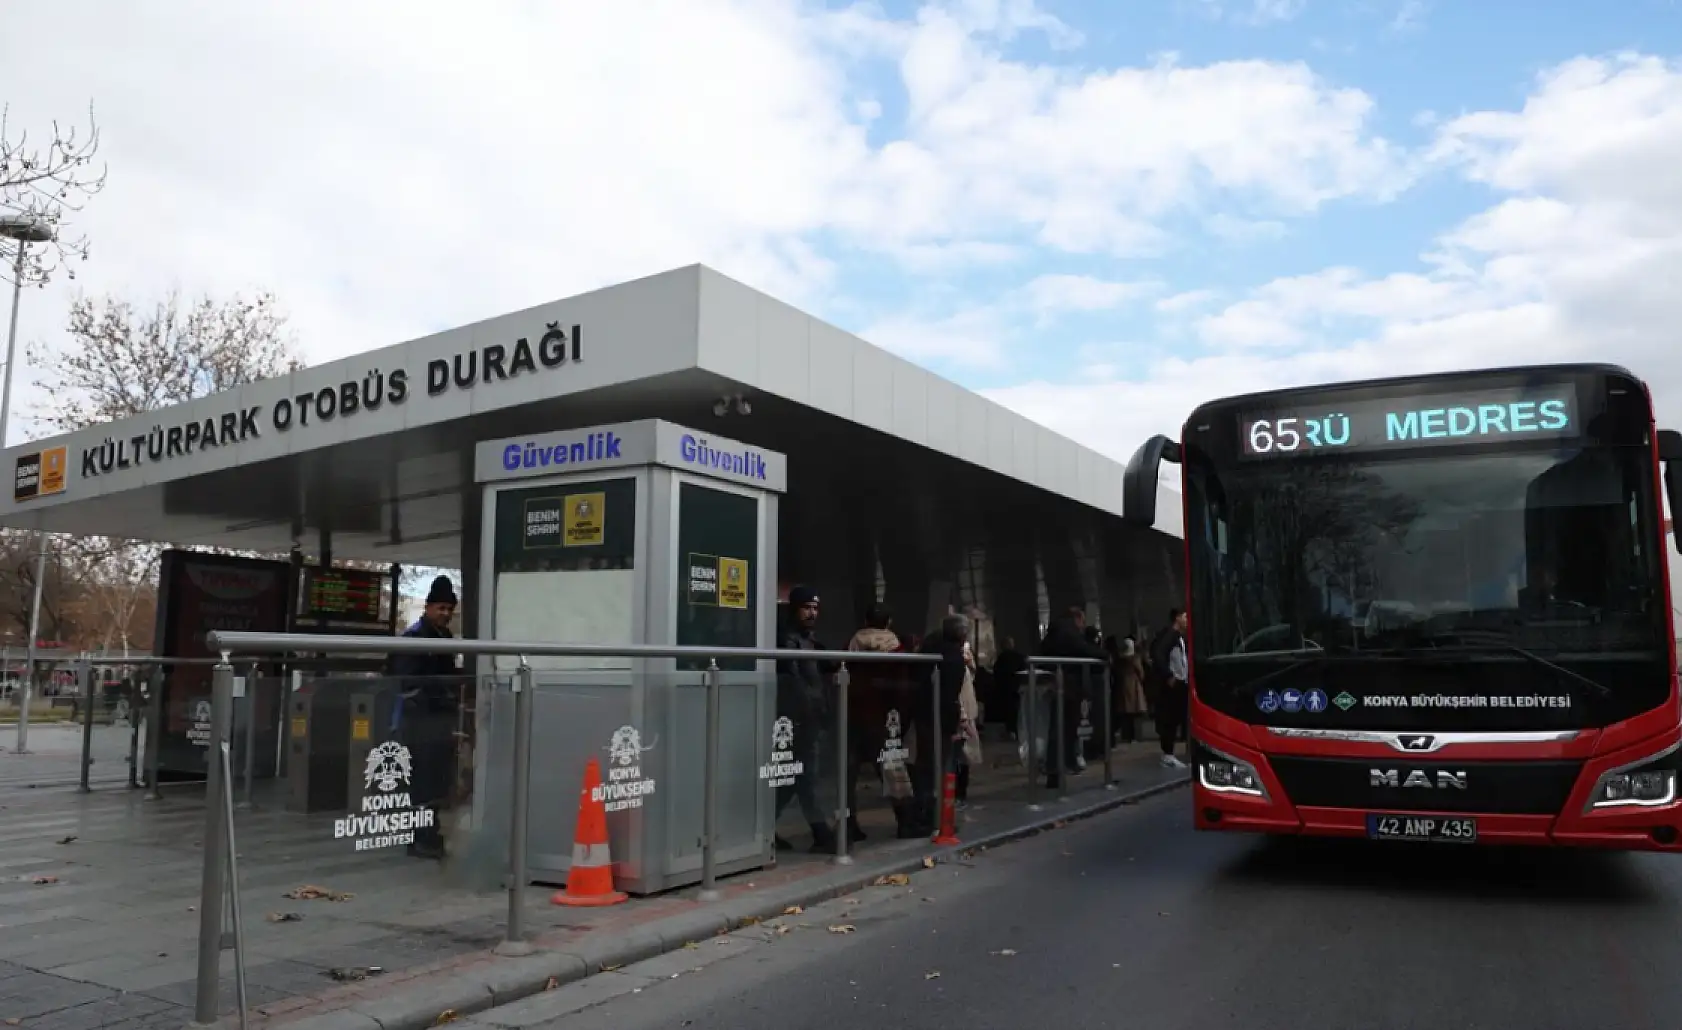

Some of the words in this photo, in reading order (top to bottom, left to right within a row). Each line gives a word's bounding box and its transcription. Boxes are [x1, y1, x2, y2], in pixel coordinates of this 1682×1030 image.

[81, 406, 262, 478] KÜLTÜRPARK
[273, 368, 409, 430] OTOBÜS
[427, 320, 583, 397] DURAĞI
[1250, 418, 1300, 453] 65
[1385, 400, 1569, 441] MEDRES
[502, 432, 622, 470] Güvenlik
[681, 433, 767, 481] Güvenlik
[1364, 695, 1408, 707] KONYA
[1411, 694, 1488, 709] BÜYÜKŞEHİR
[1490, 694, 1572, 708] BELEDİYESİ
[609, 766, 641, 781] KONYA
[1370, 769, 1468, 789] MAN
[592, 776, 656, 803] BÜYÜKŞEHİR
[362, 792, 411, 812] KONYA
[334, 805, 434, 839] BÜYÜKŞEHİR
[1378, 817, 1399, 834] 42
[1405, 819, 1435, 836] ANP
[1441, 820, 1473, 837] 435
[356, 829, 415, 851] BELEDİYESİ
